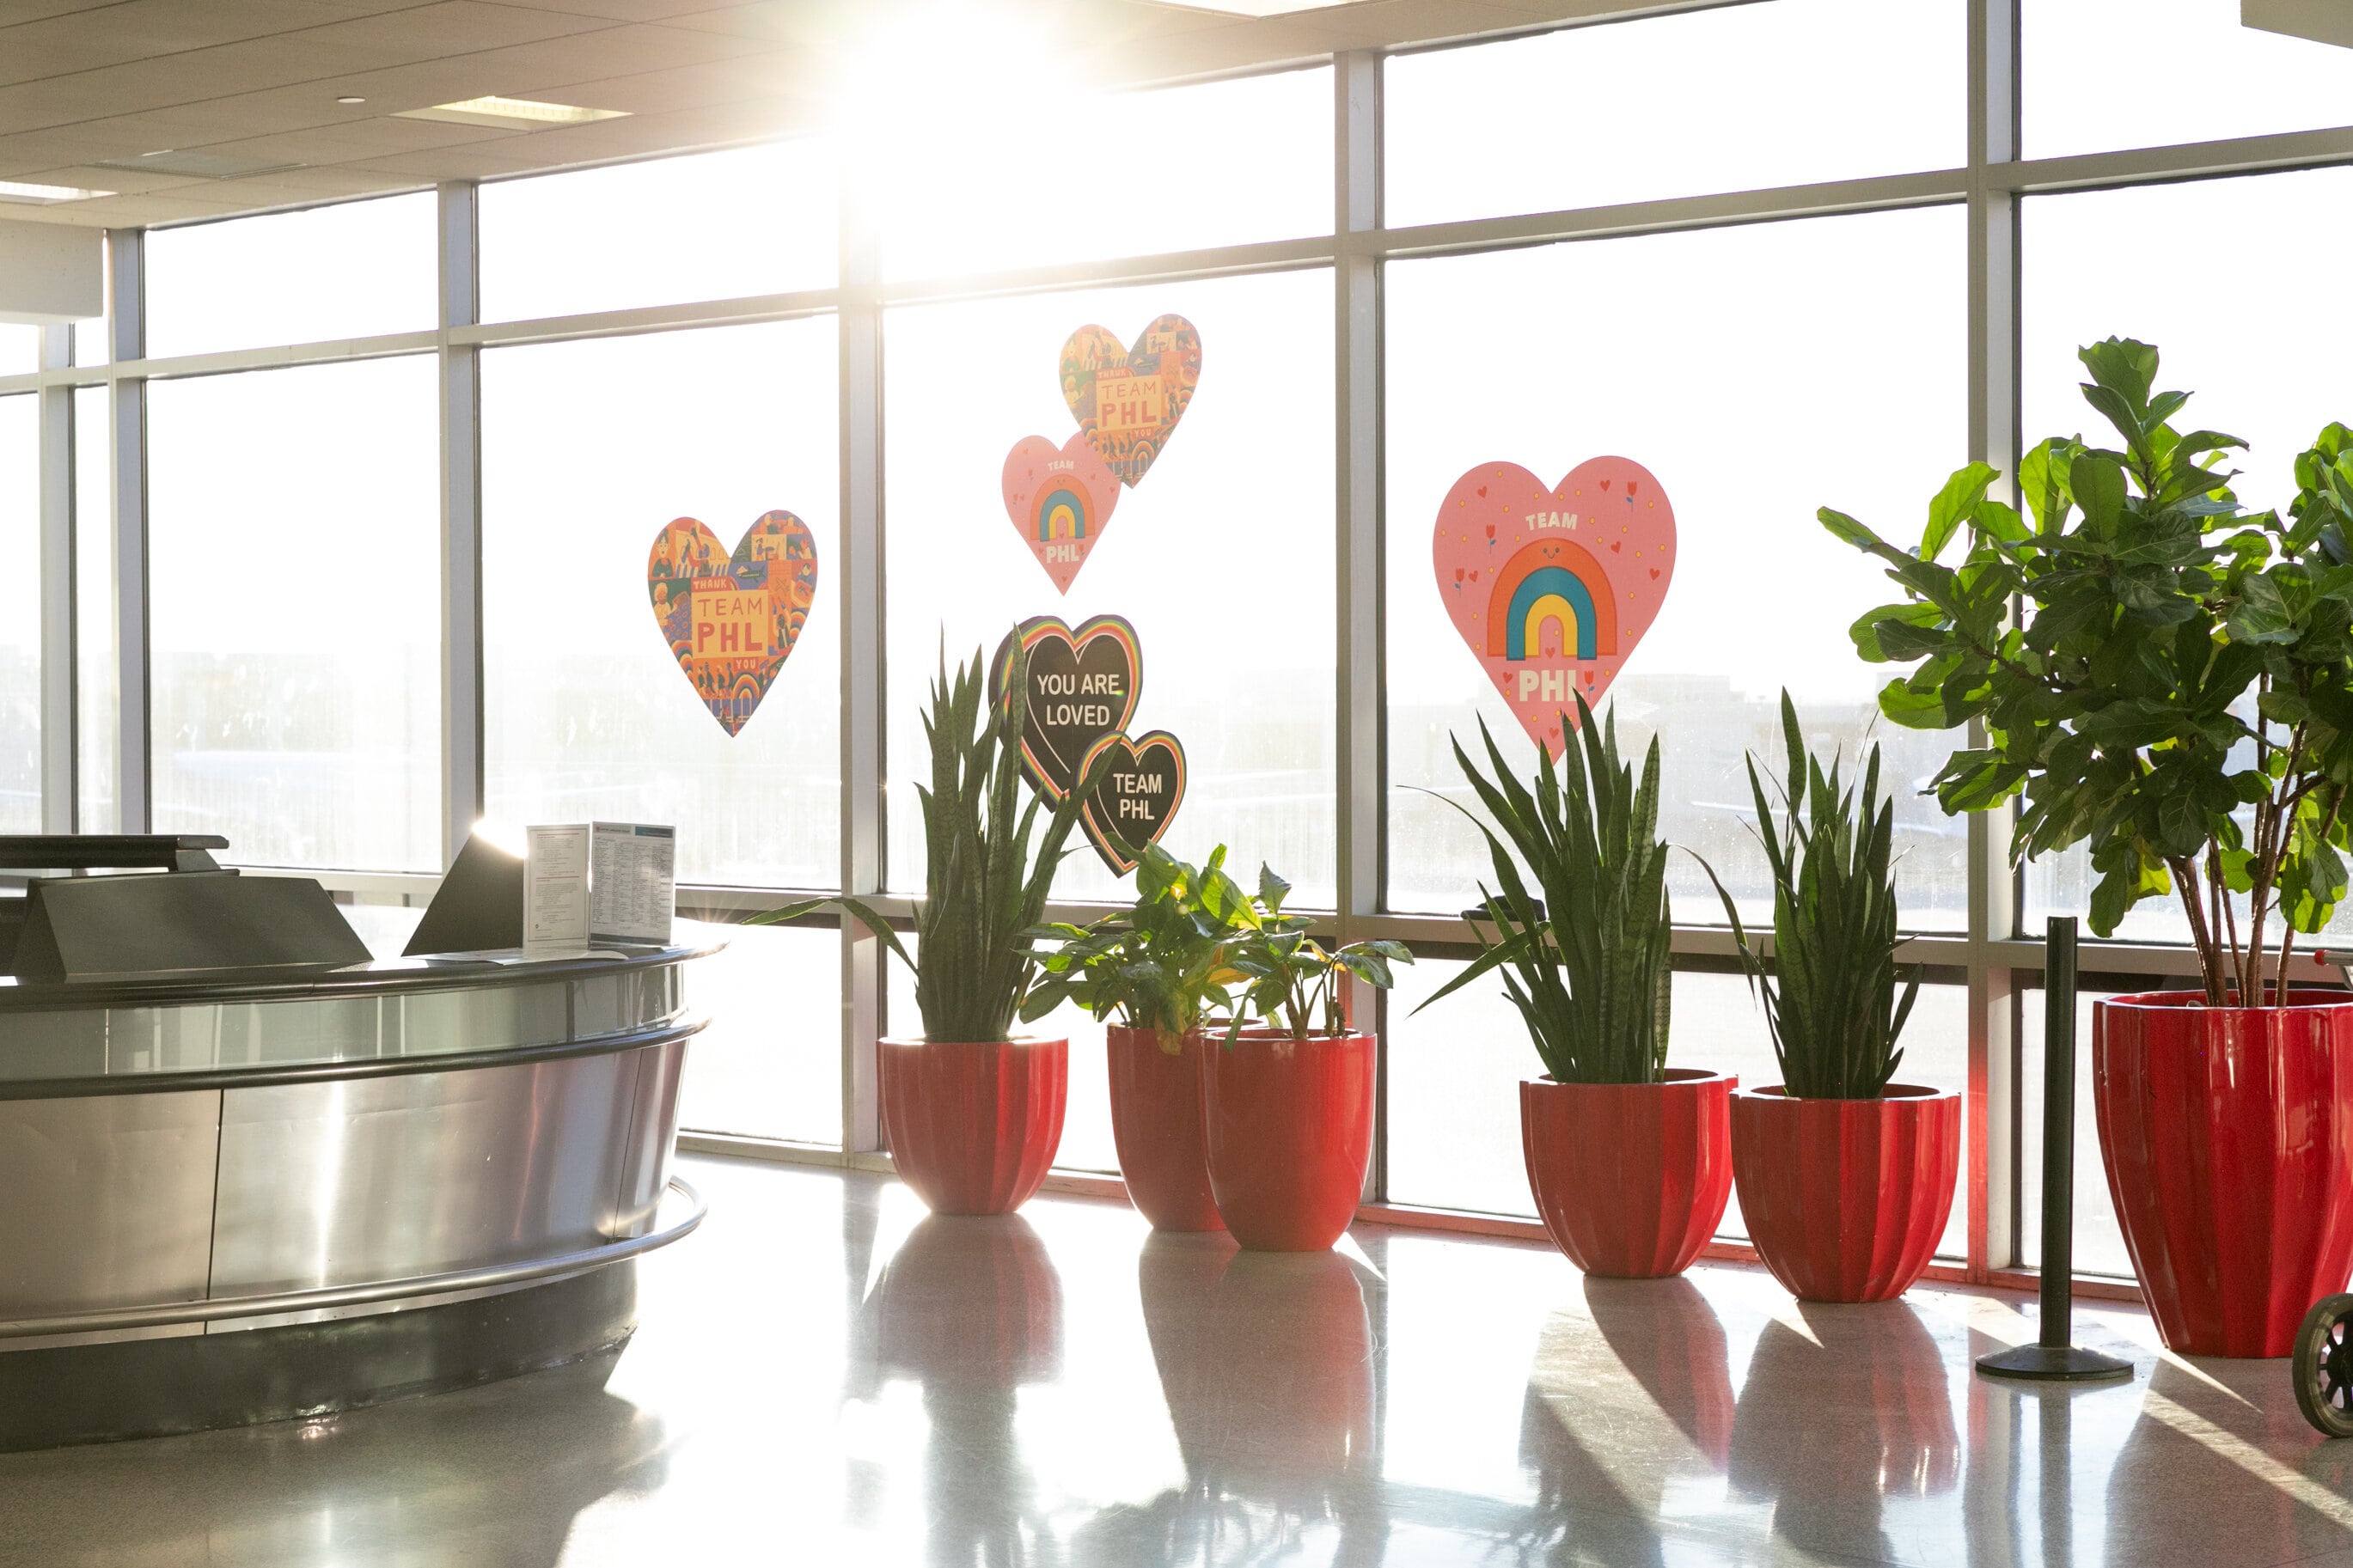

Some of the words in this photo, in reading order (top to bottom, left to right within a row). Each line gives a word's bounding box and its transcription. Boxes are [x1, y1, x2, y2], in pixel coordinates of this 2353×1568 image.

[1097, 369, 1127, 379] THANK
[1102, 381, 1156, 400] TEAM
[1102, 400, 1157, 427] PHL
[1134, 429, 1151, 437] YOU
[1048, 461, 1073, 472] TEAM
[1525, 511, 1578, 531] TEAM
[1046, 544, 1079, 564] PHL
[694, 579, 726, 590] THANK
[698, 597, 762, 617] TEAM
[698, 622, 762, 653] PHL
[736, 659, 756, 669] YOU
[1036, 674, 1075, 695] YOU
[1081, 674, 1120, 695] ARE
[1519, 669, 1583, 702] PHL
[1046, 705, 1110, 726] LOVED
[1113, 773, 1162, 794] TEAM
[1120, 799, 1155, 821] PHL
